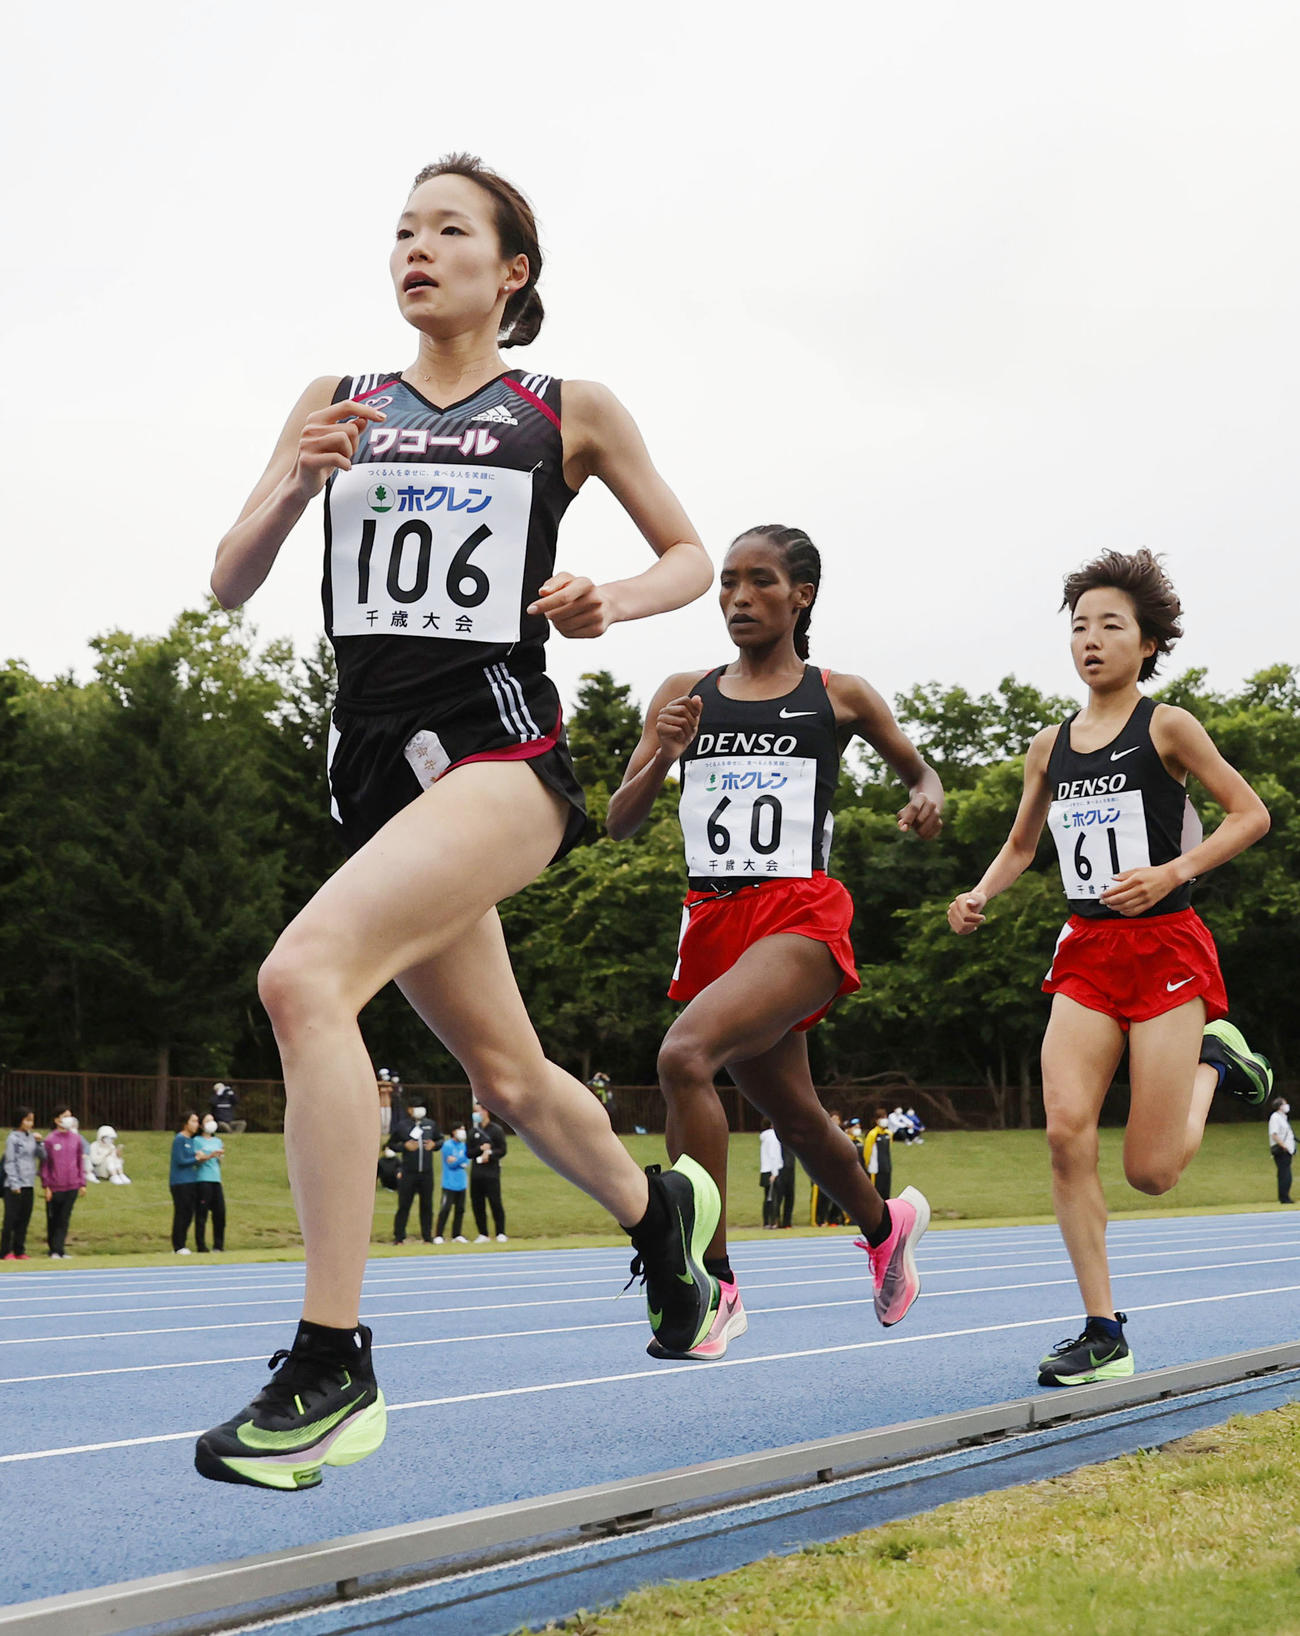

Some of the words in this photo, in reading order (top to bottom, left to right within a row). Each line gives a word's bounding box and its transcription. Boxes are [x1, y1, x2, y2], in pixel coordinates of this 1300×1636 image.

[470, 415, 519, 426] adidas
[368, 428, 500, 457] ワコール
[397, 485, 493, 513] ホクレン
[357, 519, 493, 608] 106
[366, 609, 473, 633] 千歳大会
[696, 733, 798, 756] DENSO
[721, 771, 788, 790] ホクレン
[1057, 773, 1127, 800] DENSO
[707, 794, 783, 855] 60
[1072, 807, 1120, 827] ホクレン
[709, 859, 779, 872] 千歳大会
[1074, 827, 1120, 881] 61
